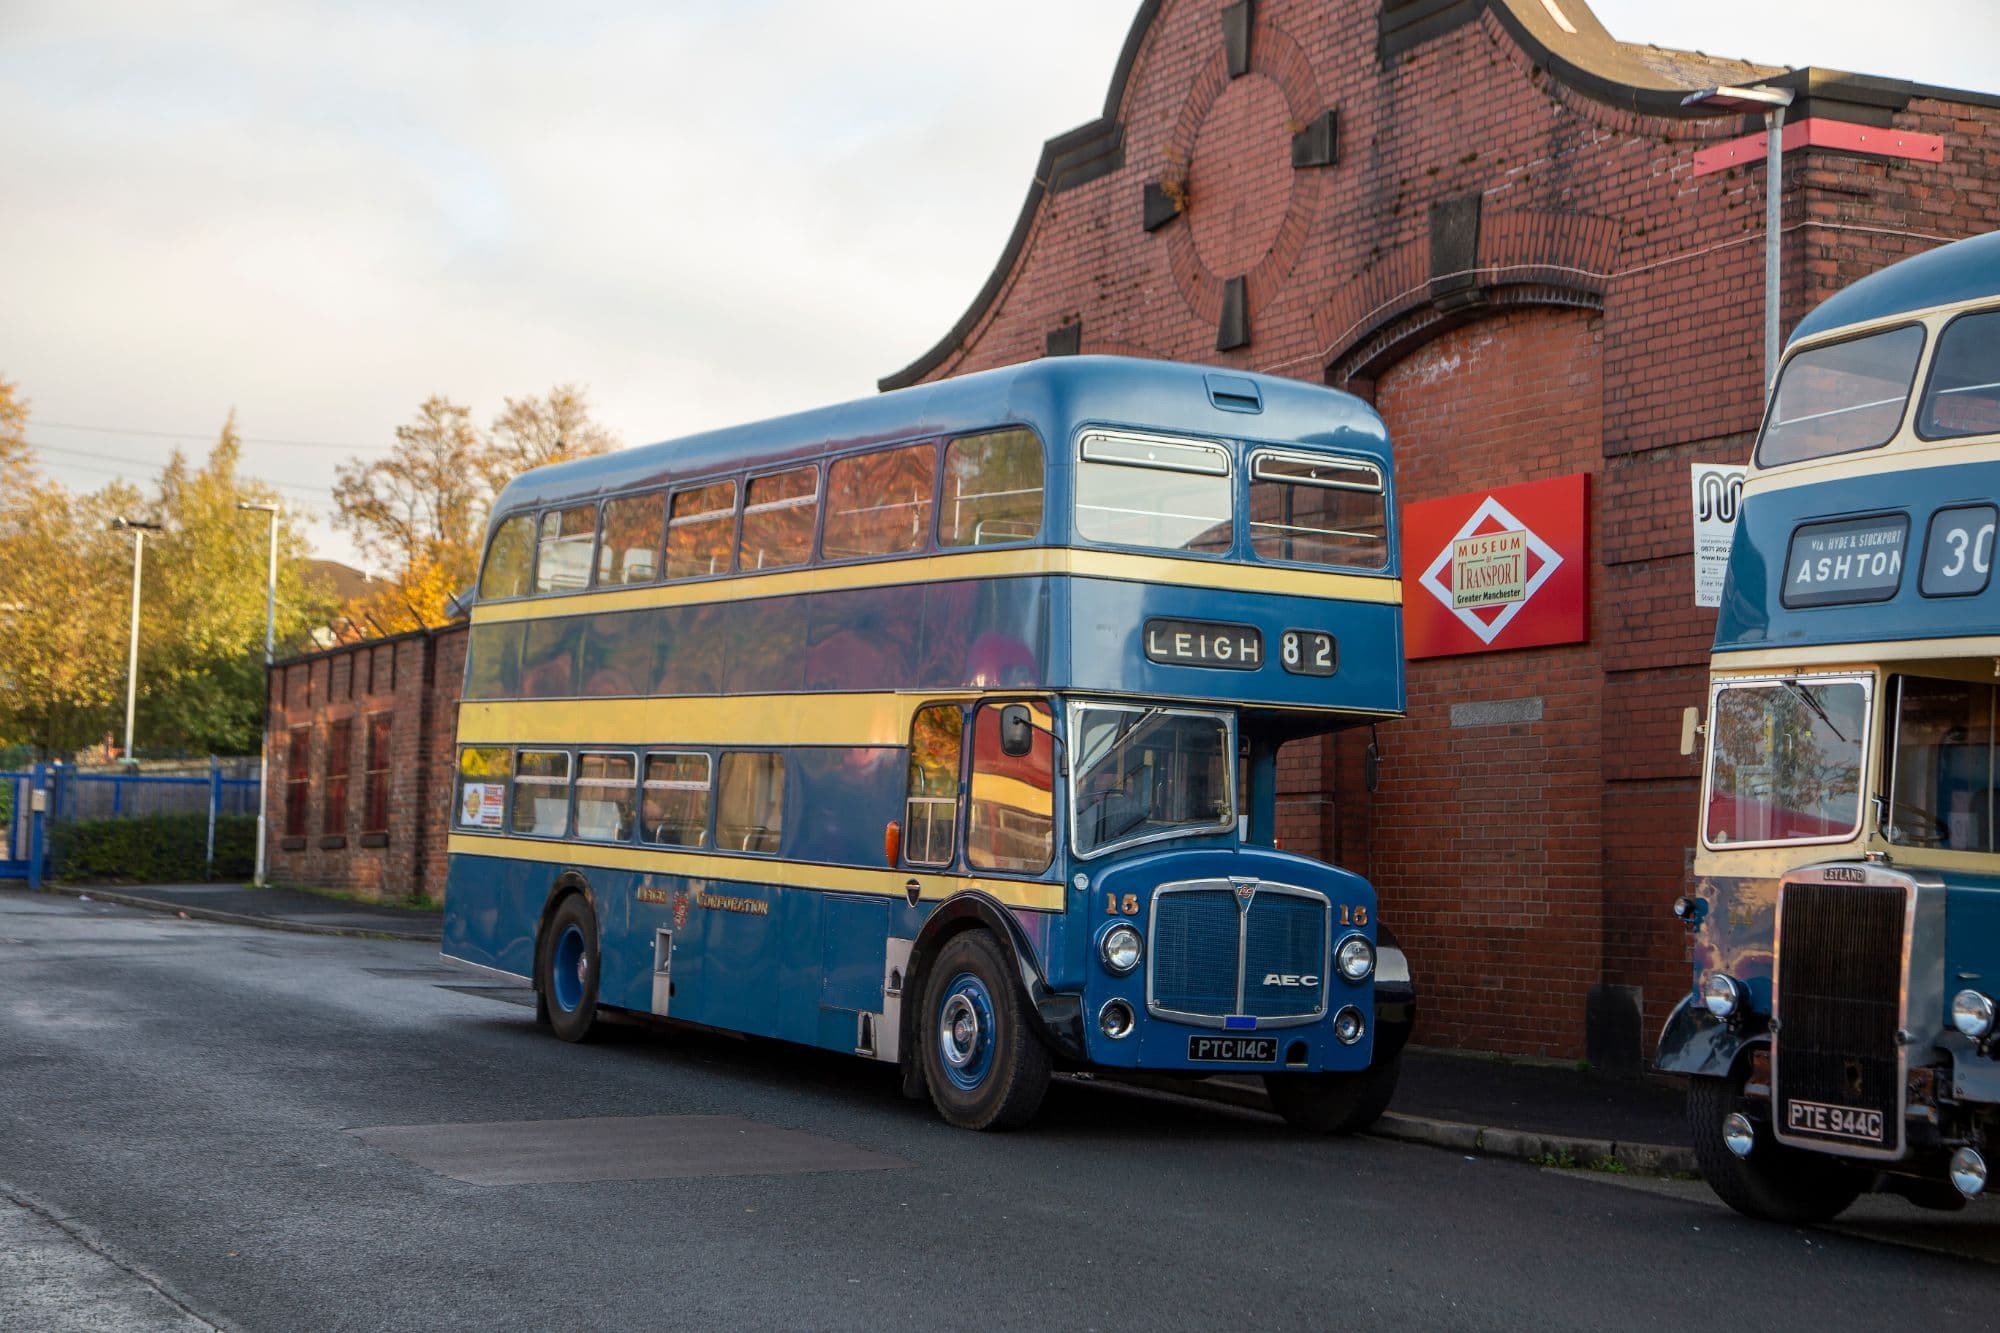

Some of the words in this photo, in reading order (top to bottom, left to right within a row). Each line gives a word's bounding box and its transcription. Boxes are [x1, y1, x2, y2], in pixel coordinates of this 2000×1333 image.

[1458, 537, 1520, 557] MUSEUM
[1811, 539, 1824, 551] VIA
[1828, 536, 1847, 550] HYDE
[1859, 530, 1901, 548] STOCKPORT
[1458, 554, 1520, 590] TRANSPORT
[1796, 550, 1900, 583] ASHTON
[1457, 593, 1482, 604] Greater
[1483, 589, 1520, 600] Manchester
[1150, 631, 1259, 663] LEIGH
[1824, 868, 1864, 880] LEYLAND
[1262, 974, 1319, 987] AEC
[1198, 1039, 1232, 1058] PTC
[1236, 1040, 1268, 1059] 114C
[1791, 1103, 1827, 1129] PTE
[1830, 1110, 1880, 1137] 944C
